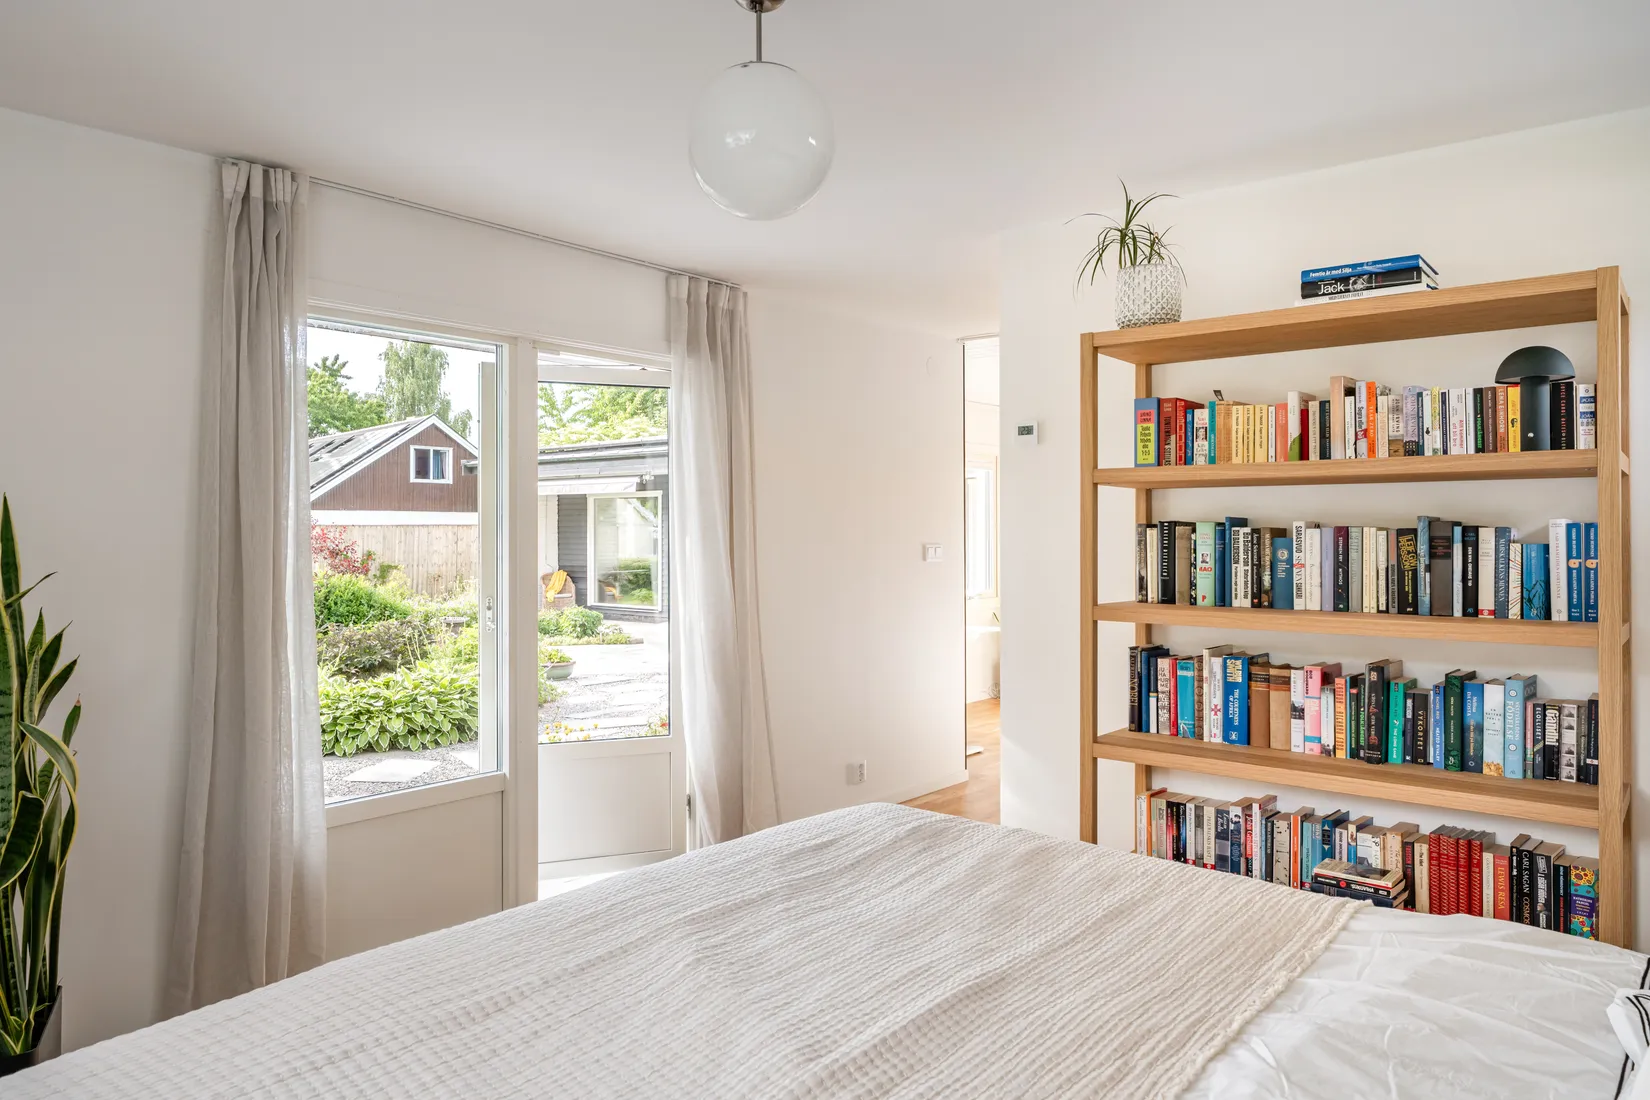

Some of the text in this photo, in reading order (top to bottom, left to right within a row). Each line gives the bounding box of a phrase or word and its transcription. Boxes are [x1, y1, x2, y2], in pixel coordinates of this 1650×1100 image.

[1318, 282, 1345, 294] Jack
[1164, 447, 1172, 466] SOTILAS
[1242, 540, 1250, 567] Balderson
[1398, 538, 1410, 569] PERSSON
[1405, 537, 1417, 566] LEIF GW
[1226, 659, 1235, 682] SMITH
[1234, 659, 1243, 683] WILBUR
[1129, 679, 1138, 706] NOBEL
[1466, 691, 1472, 699] DA
[1336, 711, 1344, 734] RICHARD
[1506, 700, 1515, 740] FÖDELSE
[1545, 709, 1559, 746] Gandhi
[1336, 736, 1344, 751] FORD
[1497, 867, 1505, 909] LEWIS RESA
[1522, 852, 1530, 924] CARL SAGAN COSMOS
[1537, 877, 1545, 889] EDGAR
[1537, 889, 1545, 903] HOOVER
